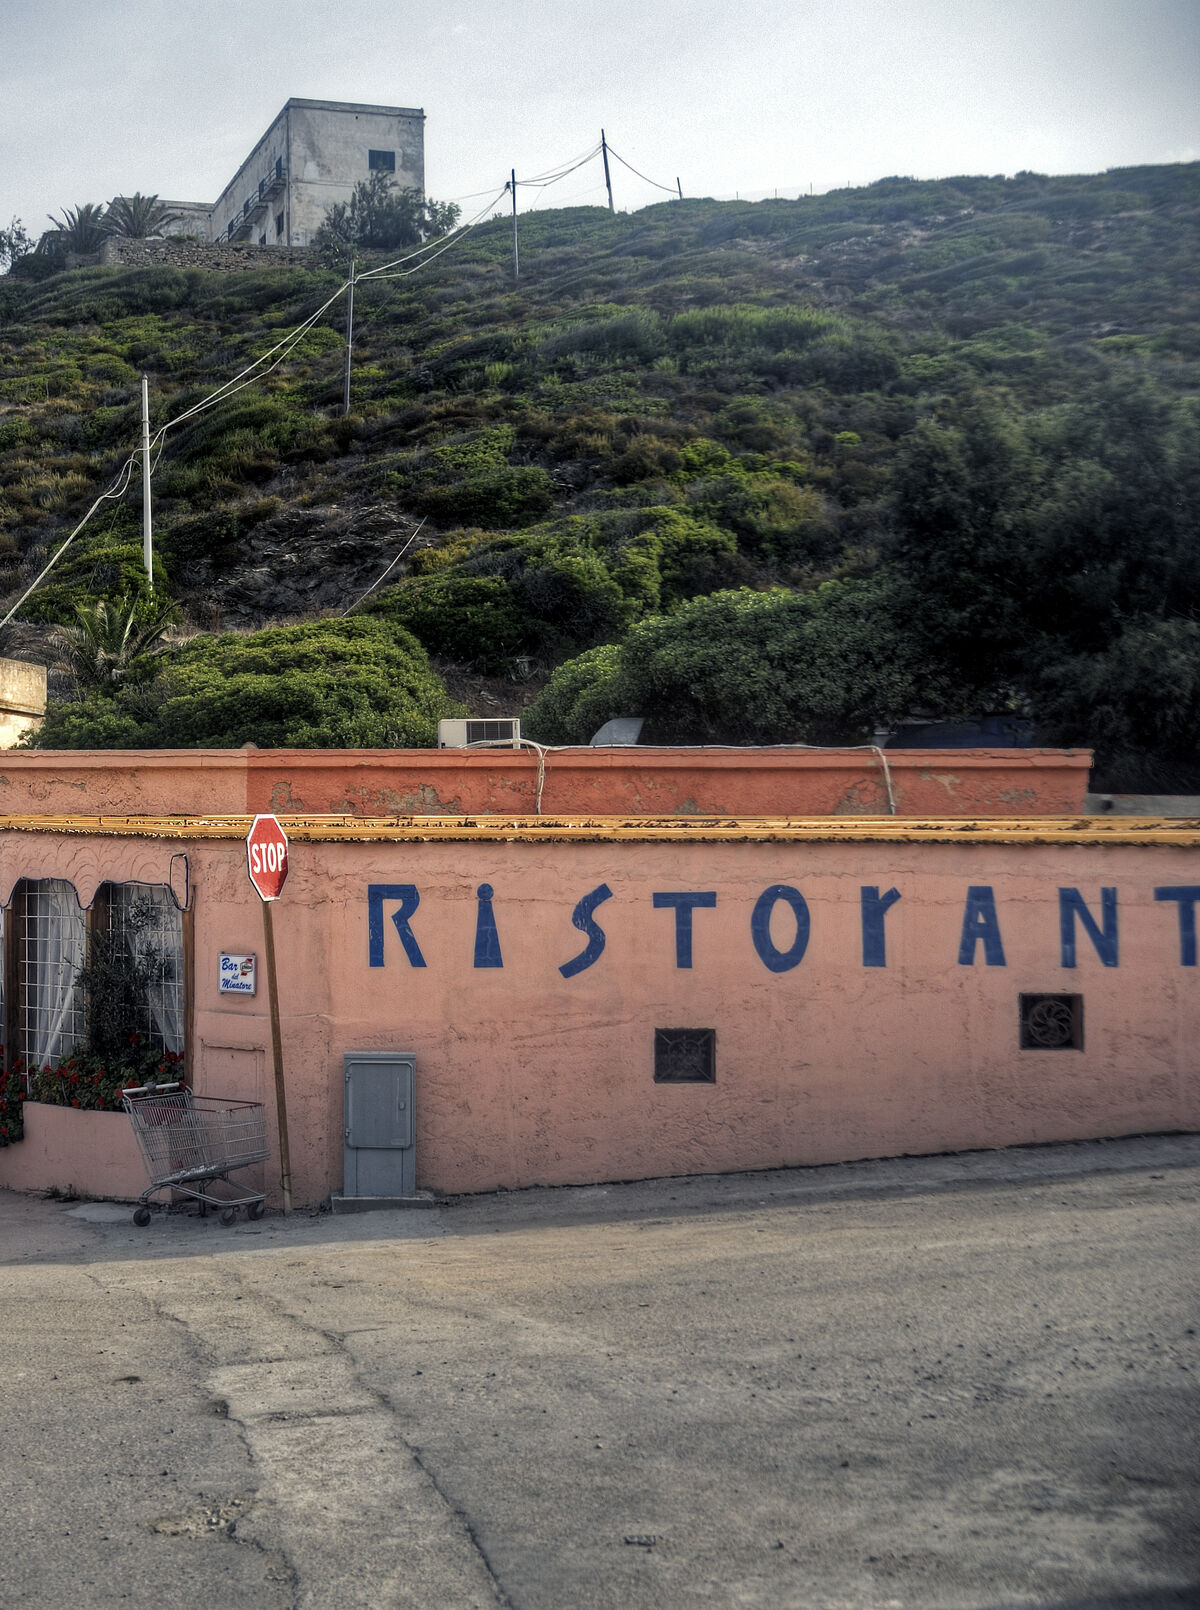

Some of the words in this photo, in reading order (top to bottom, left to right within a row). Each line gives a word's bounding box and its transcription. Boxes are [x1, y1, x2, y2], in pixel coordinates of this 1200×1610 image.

[251, 842, 286, 874] STOP
[222, 957, 238, 970] Bar
[222, 978, 252, 989] Minatore
